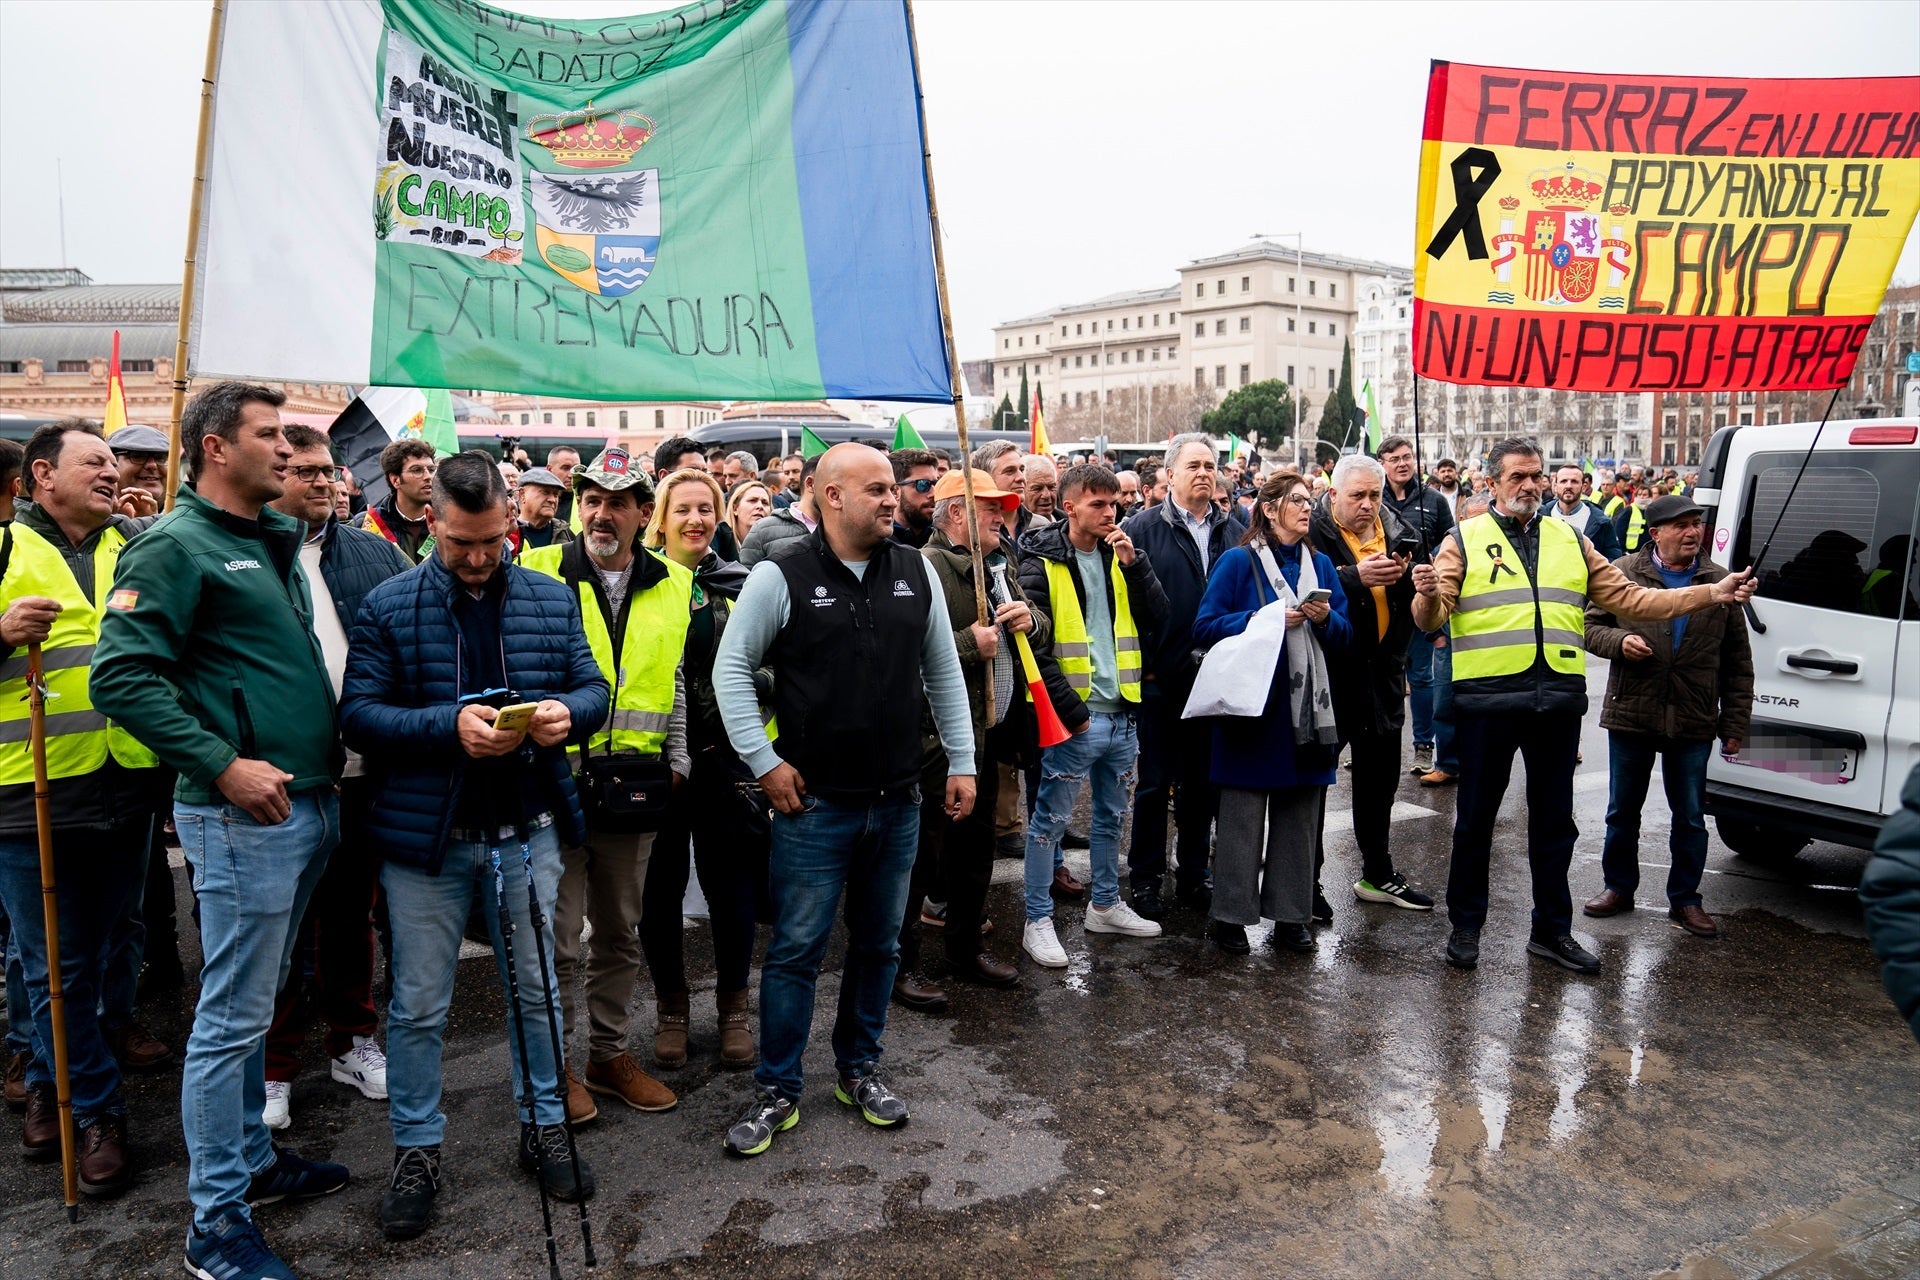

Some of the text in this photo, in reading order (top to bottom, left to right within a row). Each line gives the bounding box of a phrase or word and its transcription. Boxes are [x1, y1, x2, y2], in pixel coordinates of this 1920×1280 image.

[474, 33, 676, 83] BADAJOZ
[389, 75, 503, 151] MUERE
[387, 117, 513, 190] NUESTRO
[397, 173, 512, 234] CAMPO
[1626, 220, 1852, 317] CAMPO
[407, 263, 794, 359] EXTREMADURA
